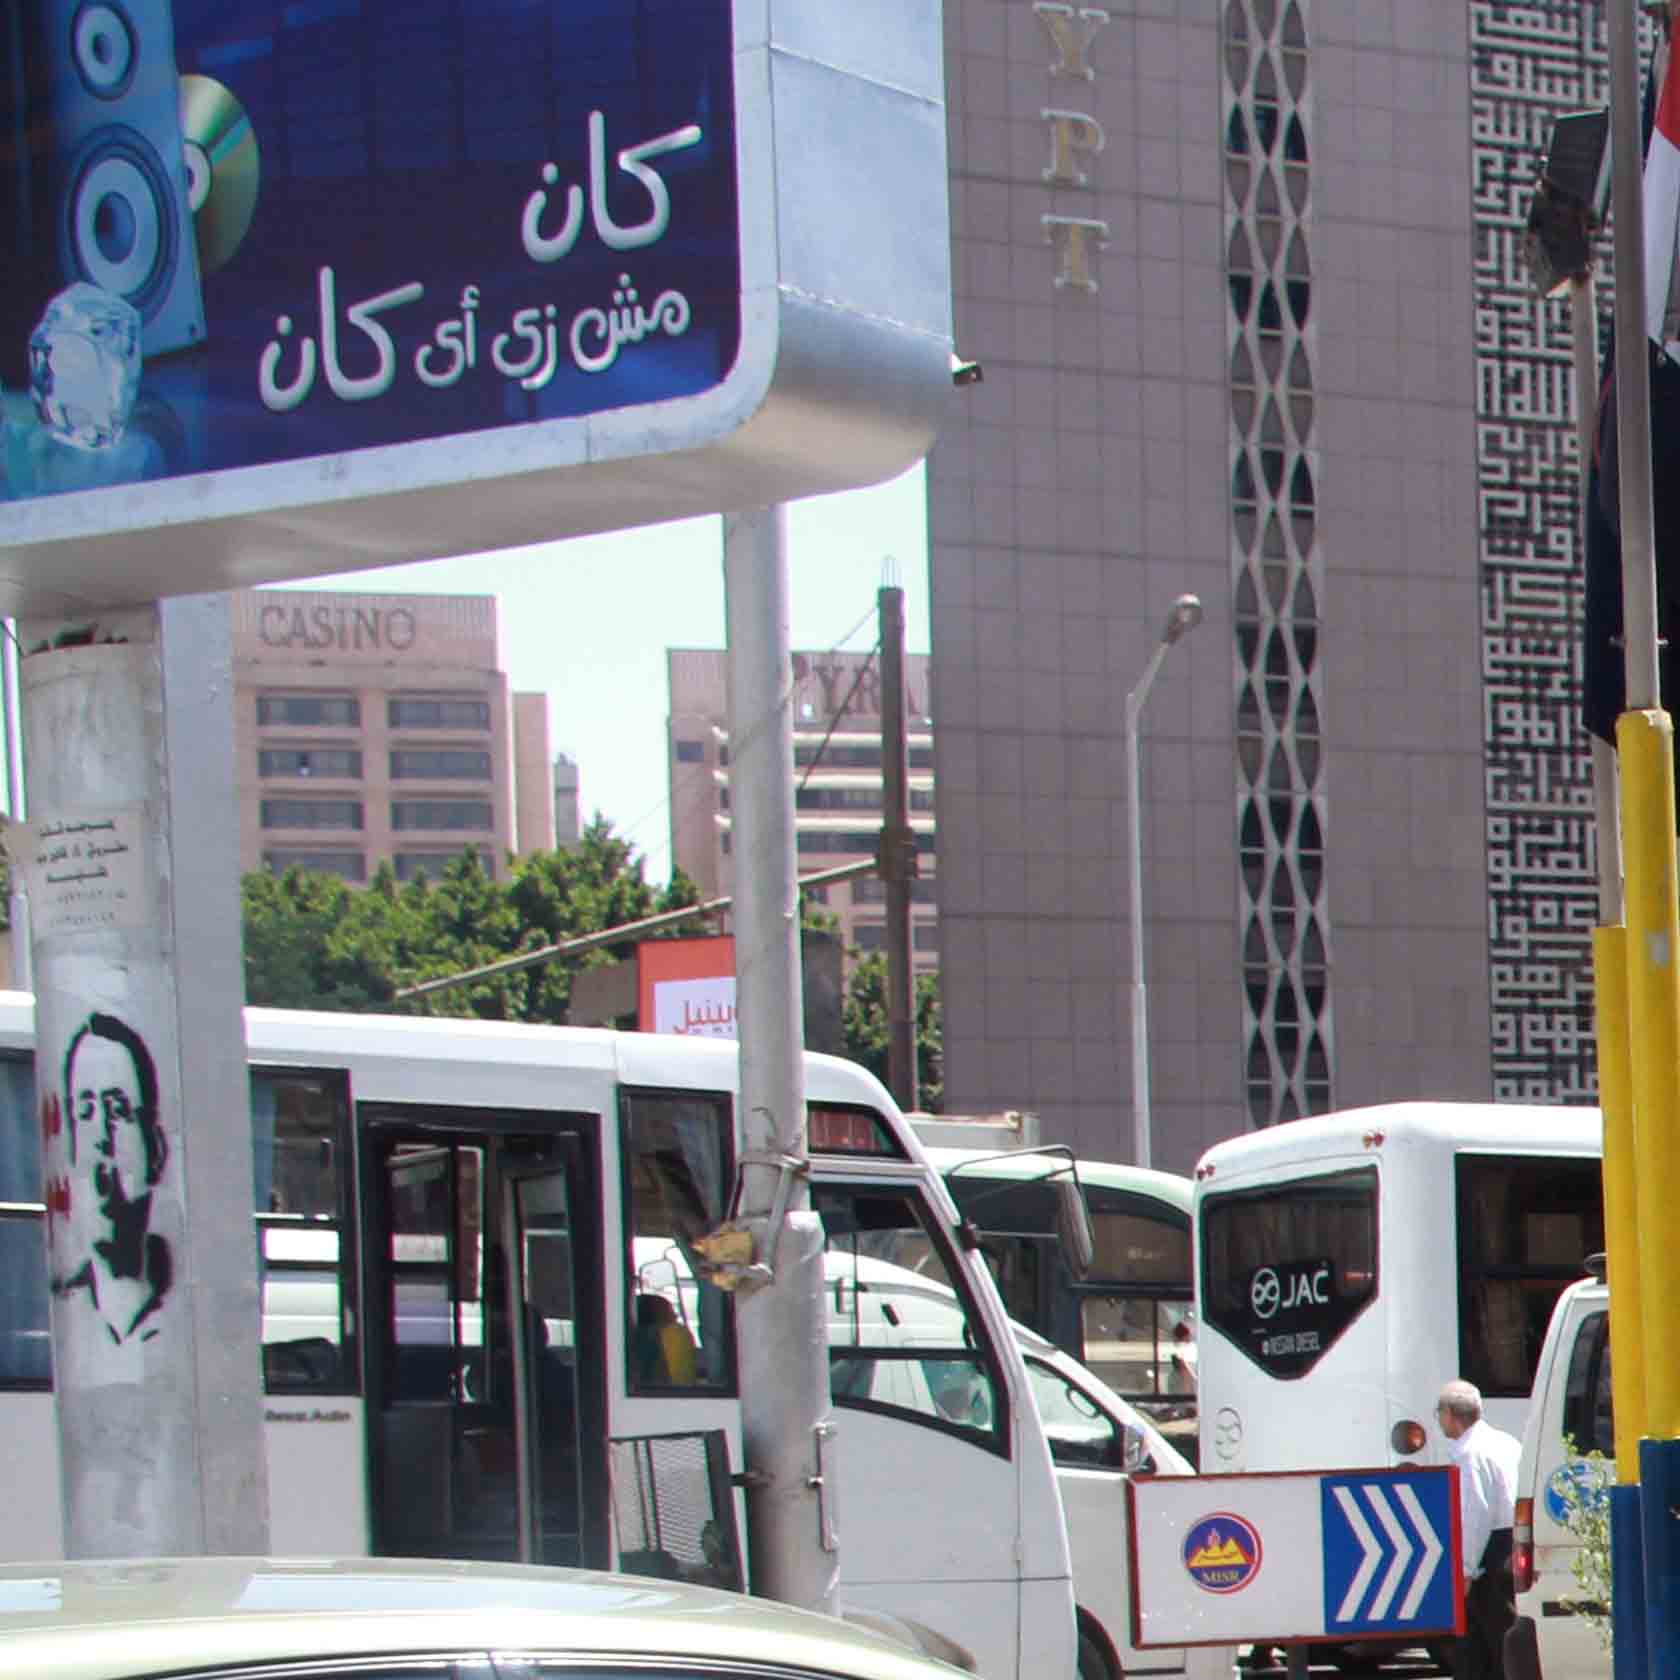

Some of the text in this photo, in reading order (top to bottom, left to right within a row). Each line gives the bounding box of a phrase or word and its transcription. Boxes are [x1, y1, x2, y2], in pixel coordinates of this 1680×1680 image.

[522, 110, 702, 262] كان
[259, 266, 424, 412] كان
[570, 273, 690, 372] مش
[258, 604, 417, 651] CASINO
[1282, 1269, 1329, 1308] JAC
